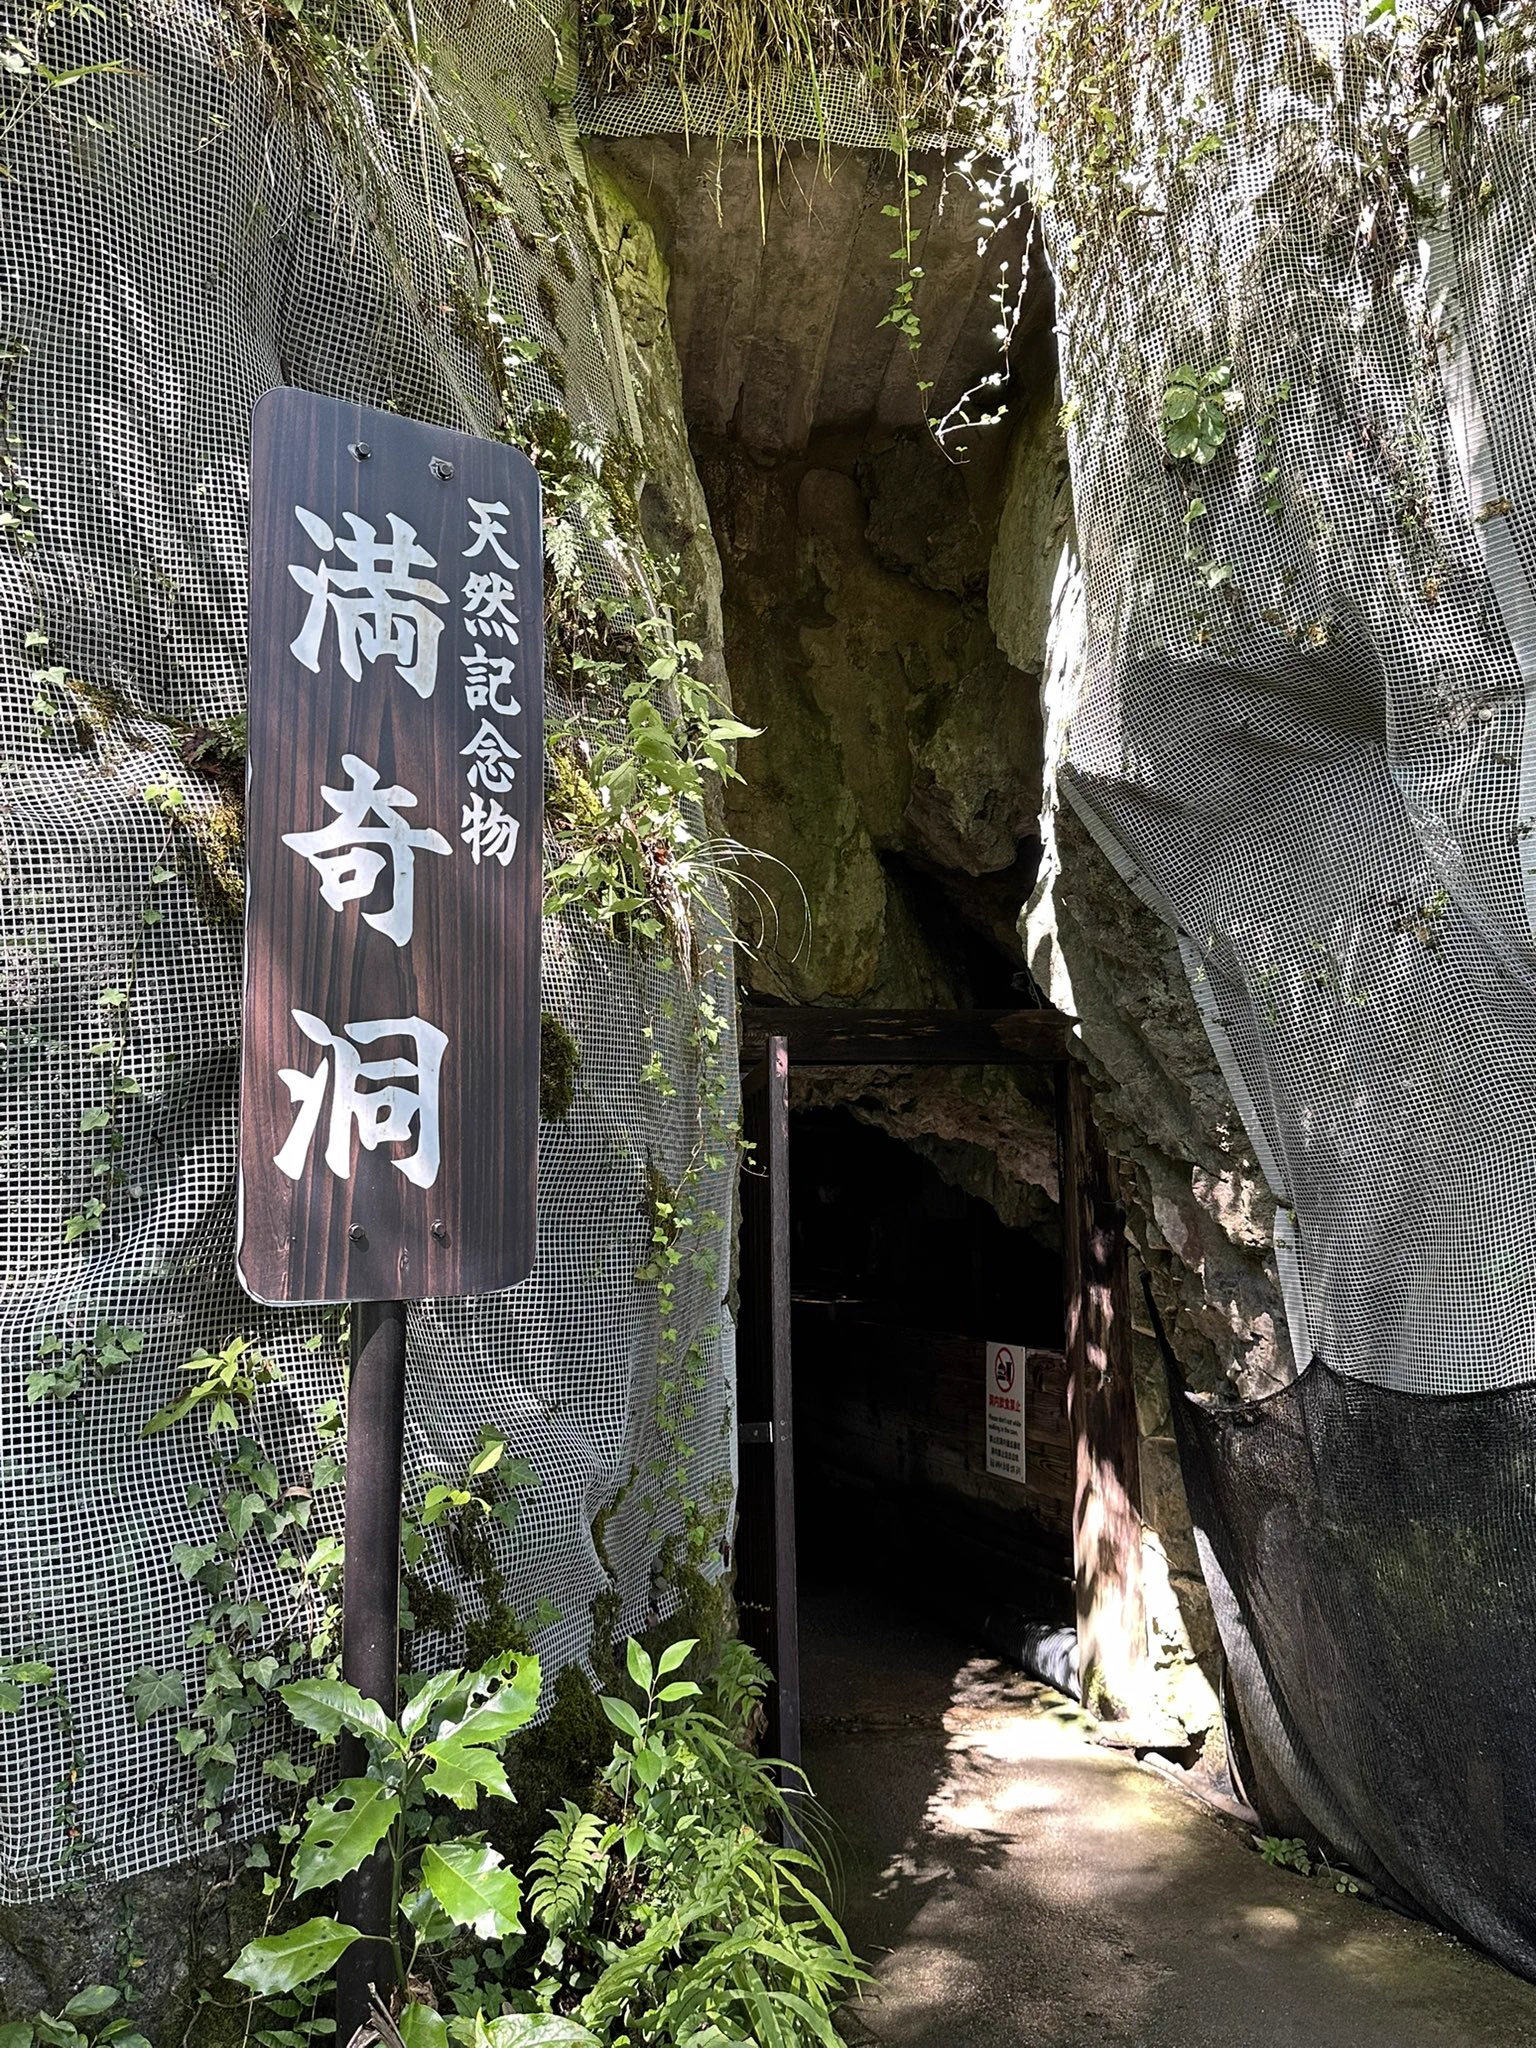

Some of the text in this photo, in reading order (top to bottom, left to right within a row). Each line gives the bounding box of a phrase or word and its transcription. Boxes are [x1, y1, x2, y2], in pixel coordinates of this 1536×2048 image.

[272, 504, 454, 1190] 満奇洞
[460, 497, 522, 868] 天然記念物
